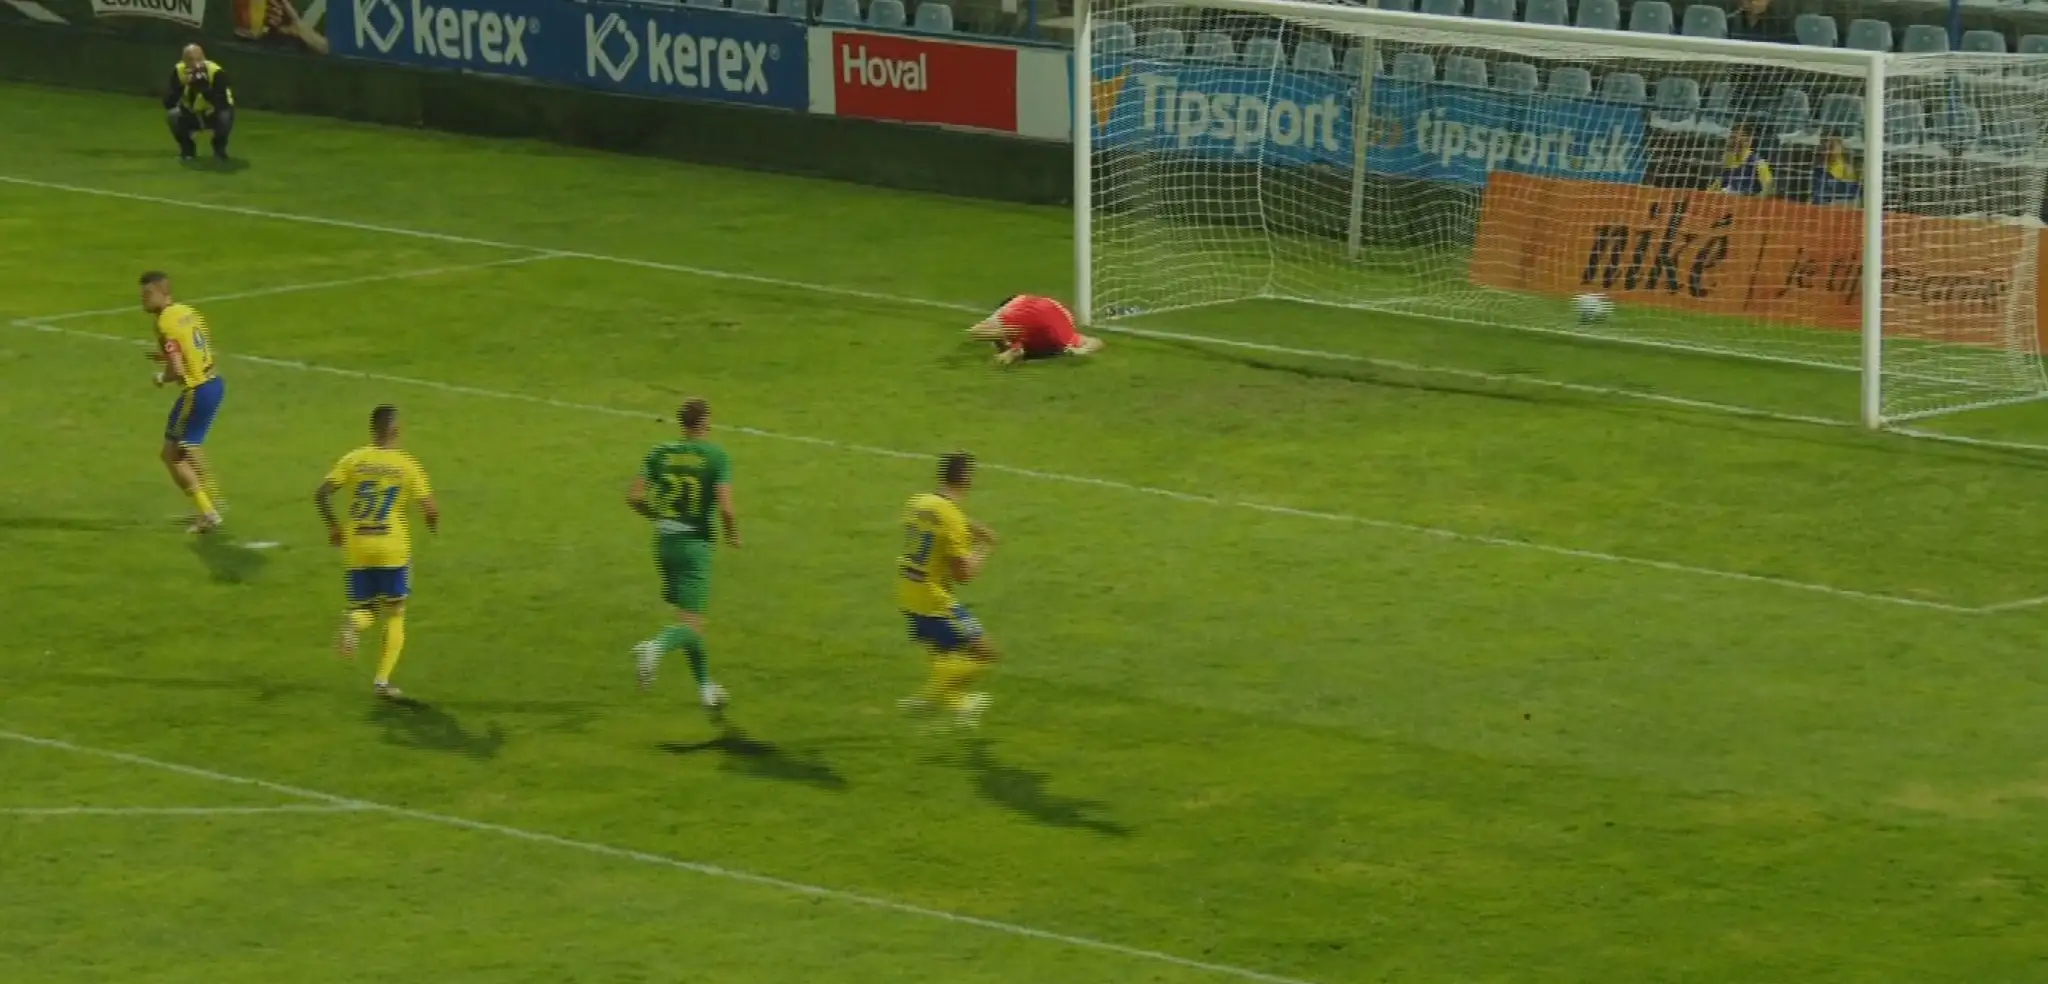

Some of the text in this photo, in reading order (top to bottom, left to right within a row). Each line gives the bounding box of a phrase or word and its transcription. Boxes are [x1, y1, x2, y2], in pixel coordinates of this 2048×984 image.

[842, 44, 927, 91] Hoval
[1138, 74, 1341, 154] Tipsport
[1415, 110, 1632, 173] tipsport.sk
[1581, 197, 1733, 297] niké
[349, 480, 400, 521] 51
